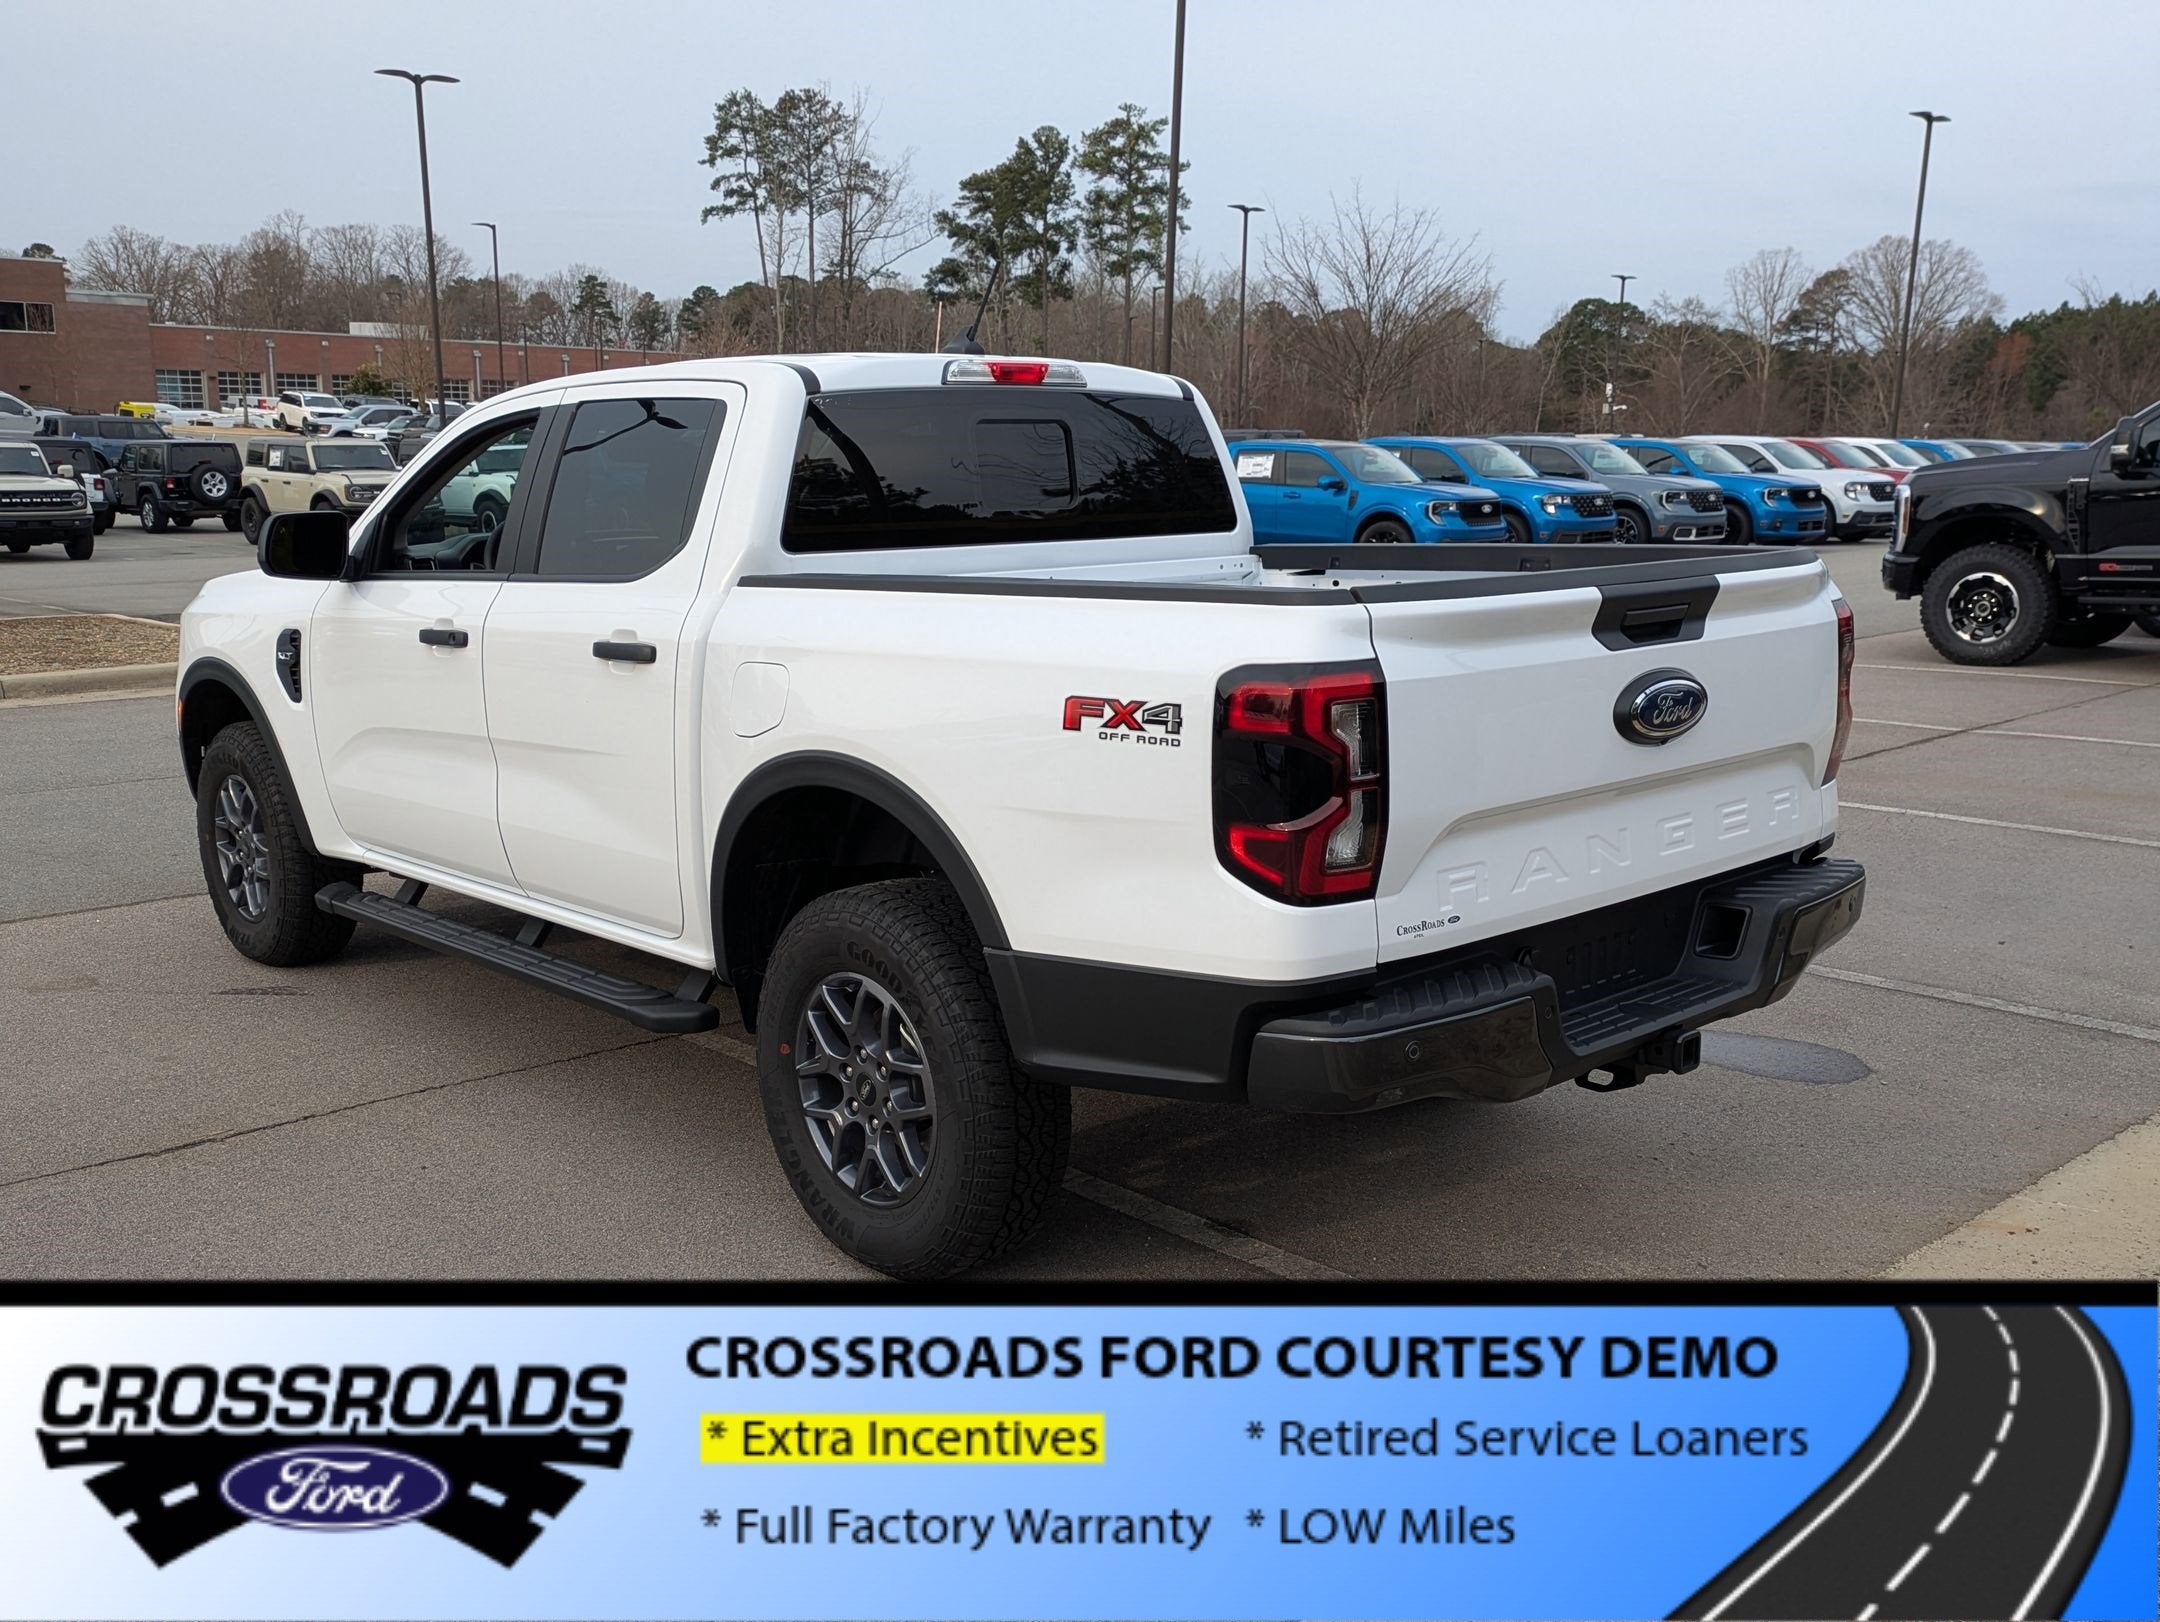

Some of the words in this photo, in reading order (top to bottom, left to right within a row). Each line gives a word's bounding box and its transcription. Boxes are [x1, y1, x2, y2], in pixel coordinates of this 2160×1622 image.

[1062, 695, 1183, 735] FX4
[1653, 691, 1694, 725] Ford
[1098, 731, 1131, 742] OFF
[1136, 734, 1181, 748] ROAD
[1436, 785, 1801, 913] RANGER
